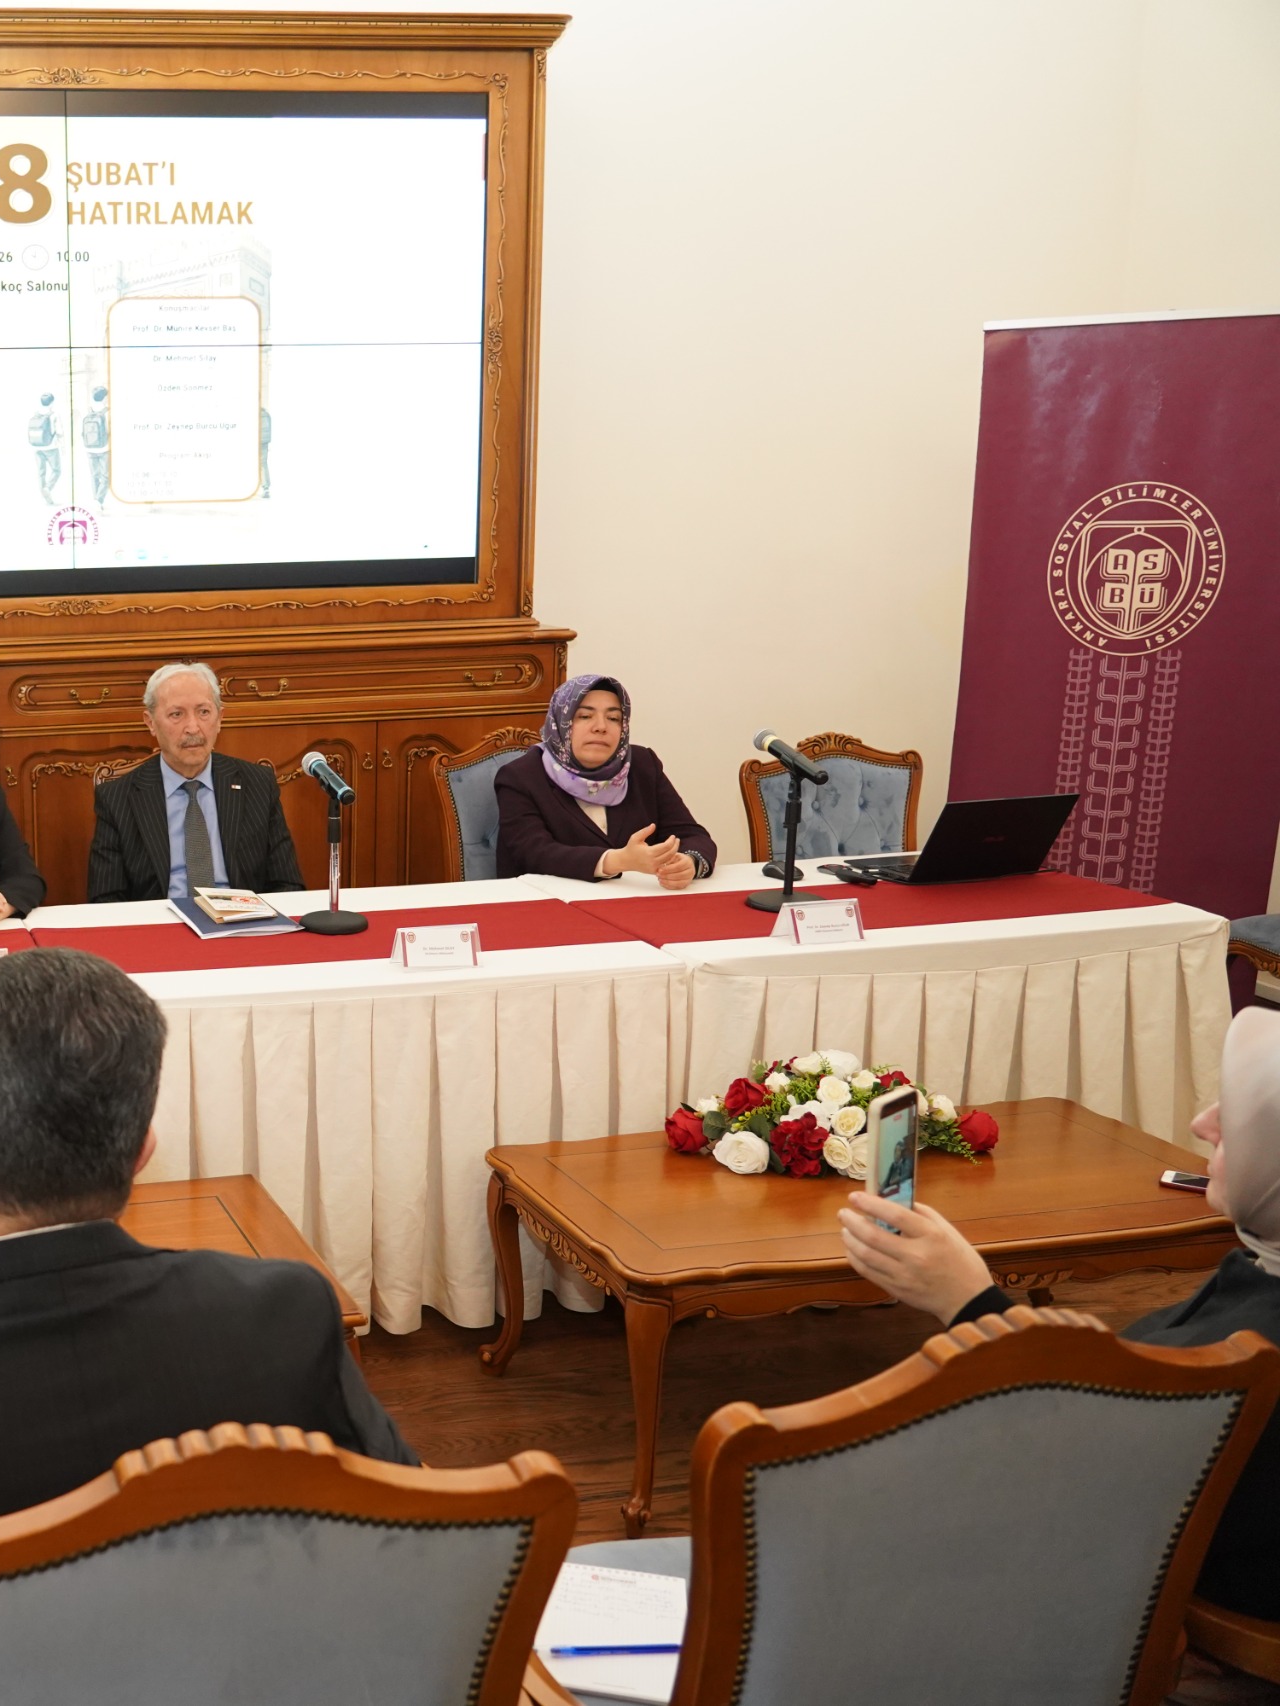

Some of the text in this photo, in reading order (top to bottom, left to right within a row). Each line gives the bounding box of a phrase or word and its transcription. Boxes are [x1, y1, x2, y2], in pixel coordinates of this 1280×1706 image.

[66, 200, 254, 226] HATIRLAMAK
[56, 250, 90, 262] 10.00
[26, 279, 68, 292] Salonu
[1053, 485, 1223, 650] ANKARA SOSYAL BİLİMLER ÜNİVERSİTESİ
